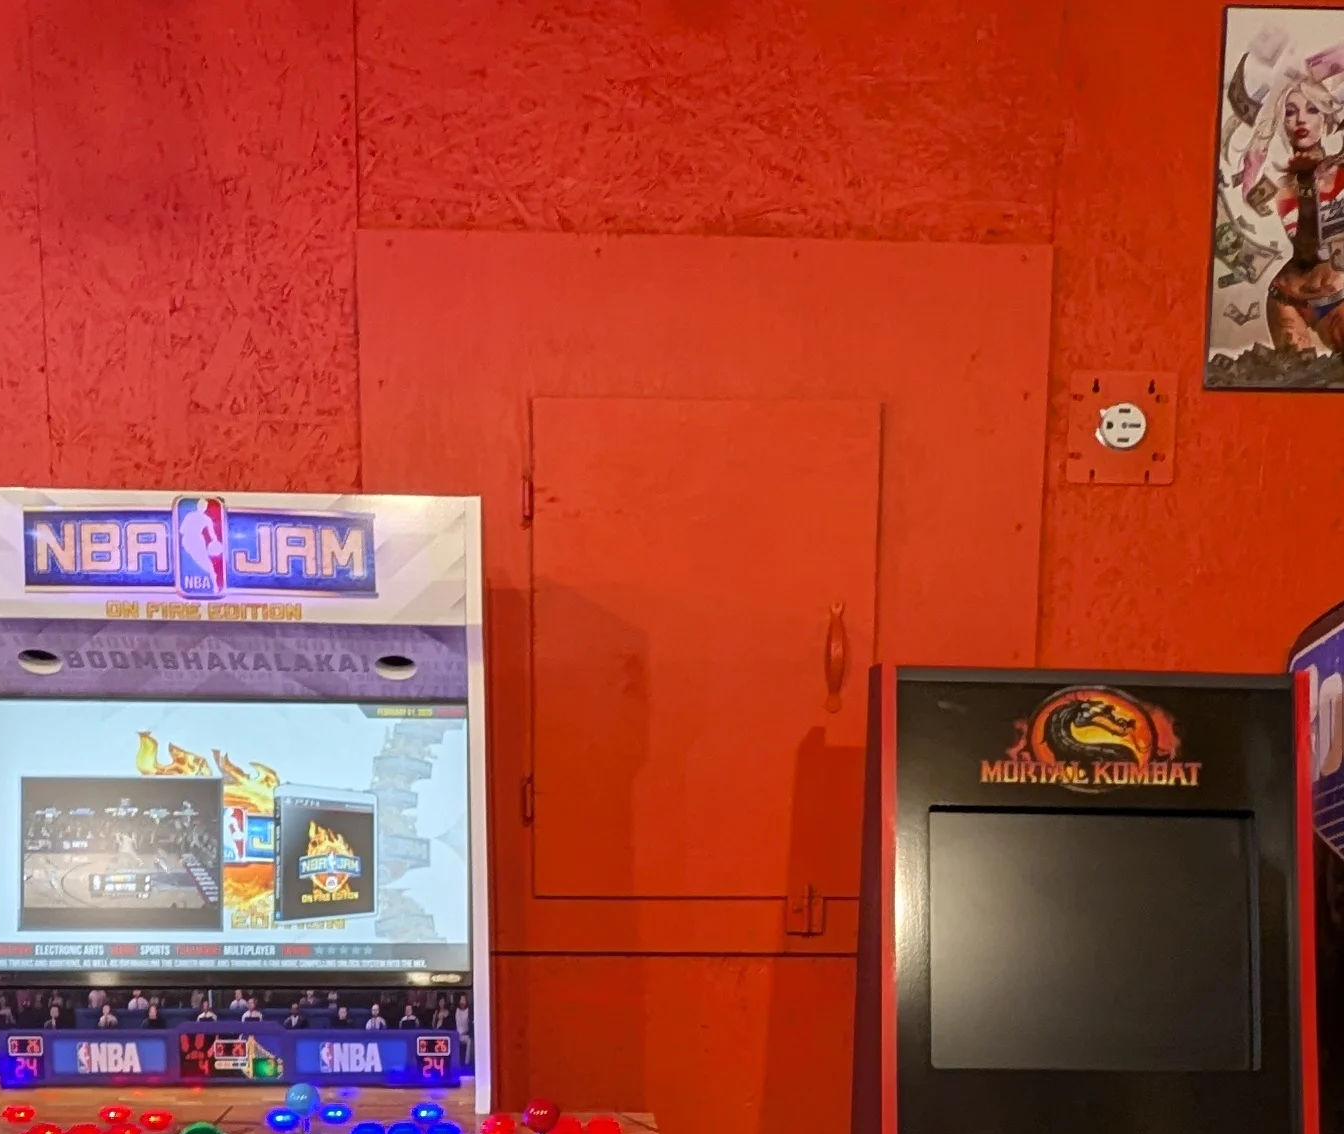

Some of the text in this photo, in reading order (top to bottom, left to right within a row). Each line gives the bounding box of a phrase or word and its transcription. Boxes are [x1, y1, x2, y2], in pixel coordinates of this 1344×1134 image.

[34, 517, 367, 579] NBA JAM
[184, 575, 212, 590] NBA
[106, 602, 302, 621] ON FIRE EDITION
[67, 650, 370, 674] BOOMSHAKALAKA!
[980, 759, 1202, 786] MORTAL KOMBAT
[35, 944, 83, 956] ELECTRONIC
[84, 944, 104, 956] ARTS
[140, 944, 170, 956] SPORTS
[223, 944, 276, 956] MULTIPLAYER
[90, 1042, 143, 1073] NBA
[332, 1042, 385, 1073] NBA
